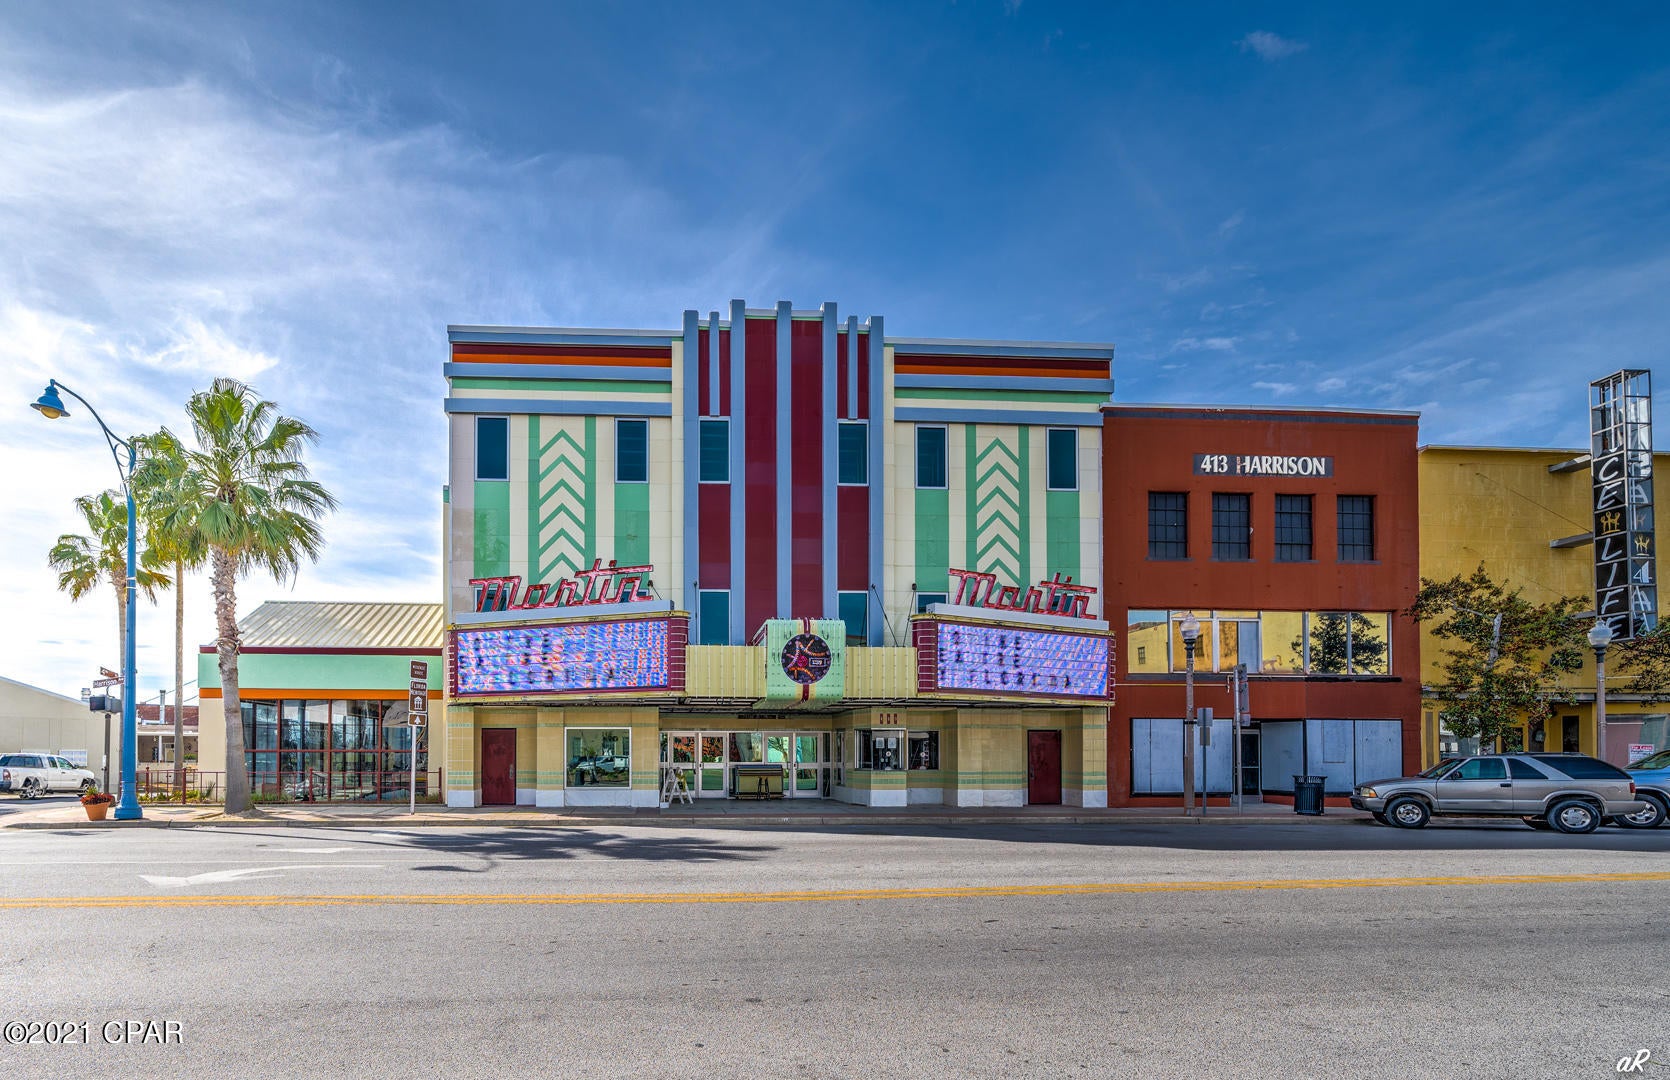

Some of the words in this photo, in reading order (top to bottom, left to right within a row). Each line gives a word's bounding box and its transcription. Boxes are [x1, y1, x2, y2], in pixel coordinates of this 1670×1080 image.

[1200, 455, 1228, 473] 413
[1236, 455, 1326, 475] HARRISON
[469, 558, 654, 612] Martin
[948, 568, 1098, 620] Martin
